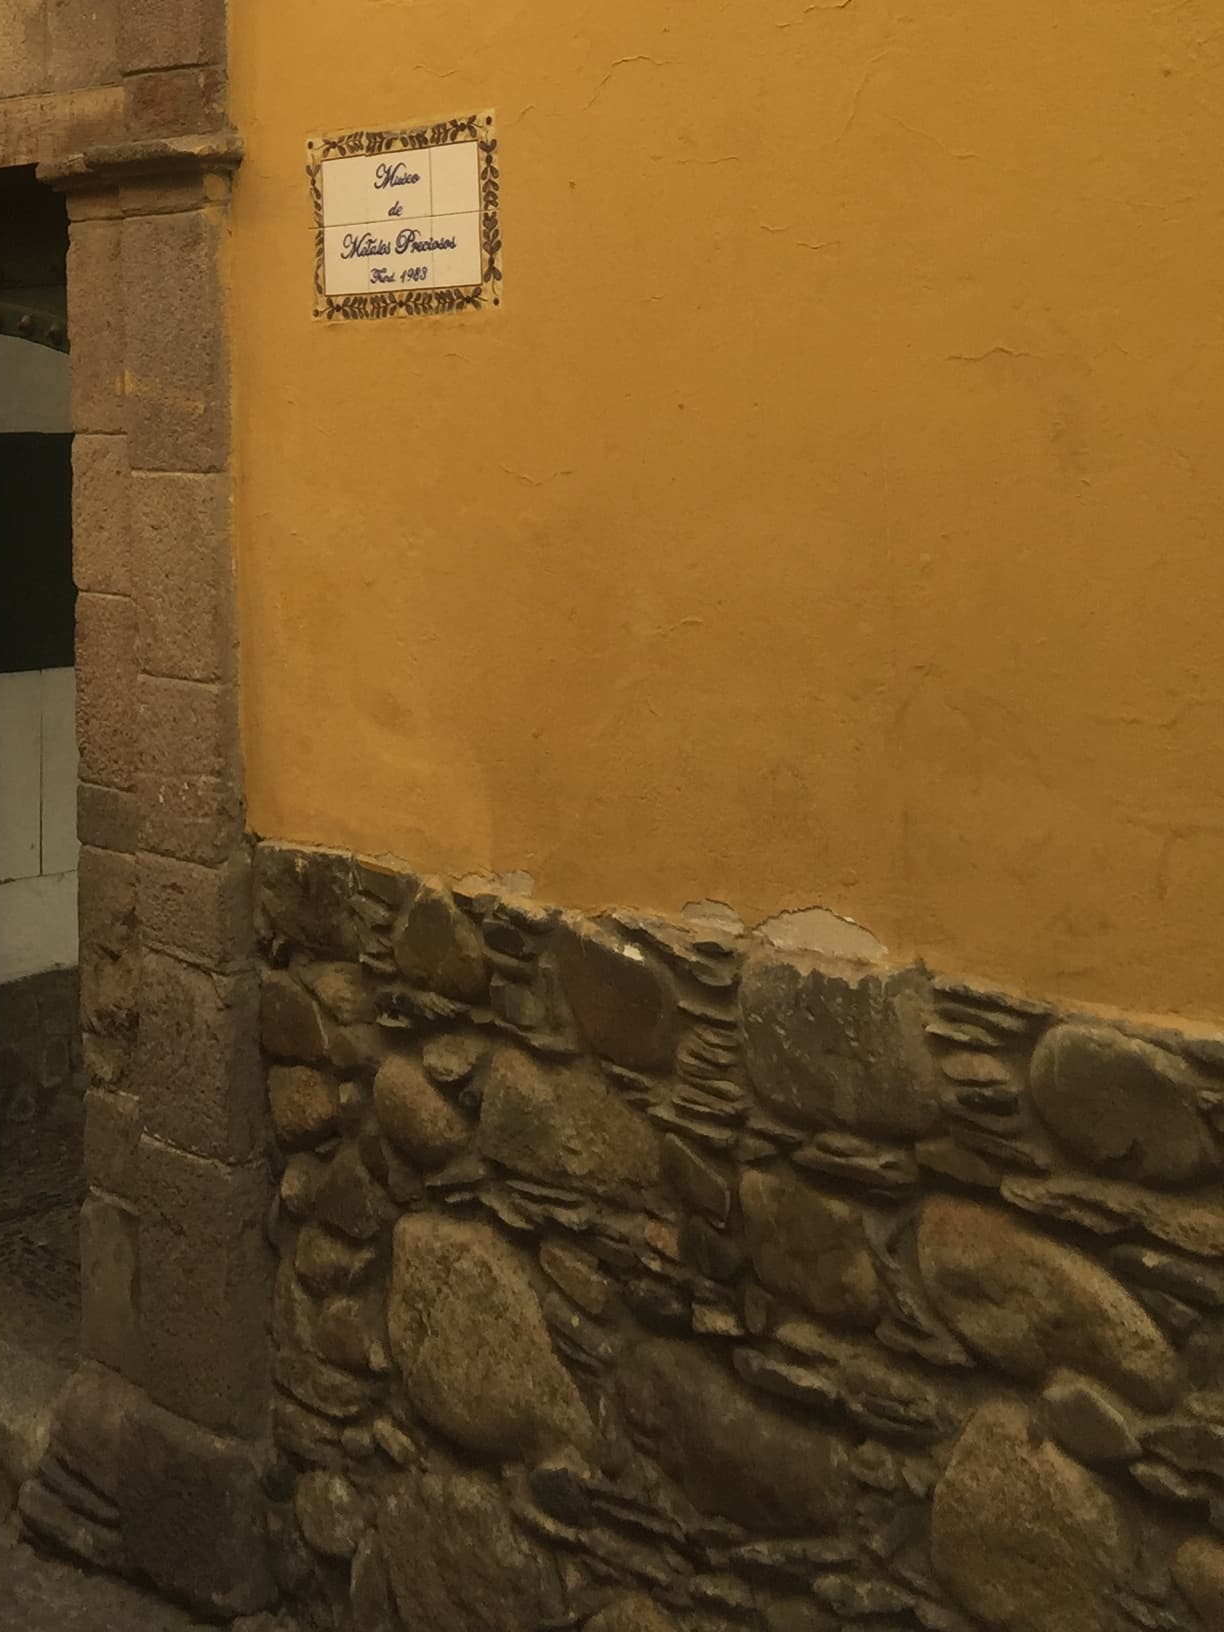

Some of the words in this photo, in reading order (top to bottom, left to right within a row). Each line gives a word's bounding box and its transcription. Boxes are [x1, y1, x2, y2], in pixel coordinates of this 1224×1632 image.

[374, 162, 421, 189] Museo
[388, 201, 403, 216] de
[340, 232, 391, 259] Metales
[395, 228, 457, 254] Preciosos
